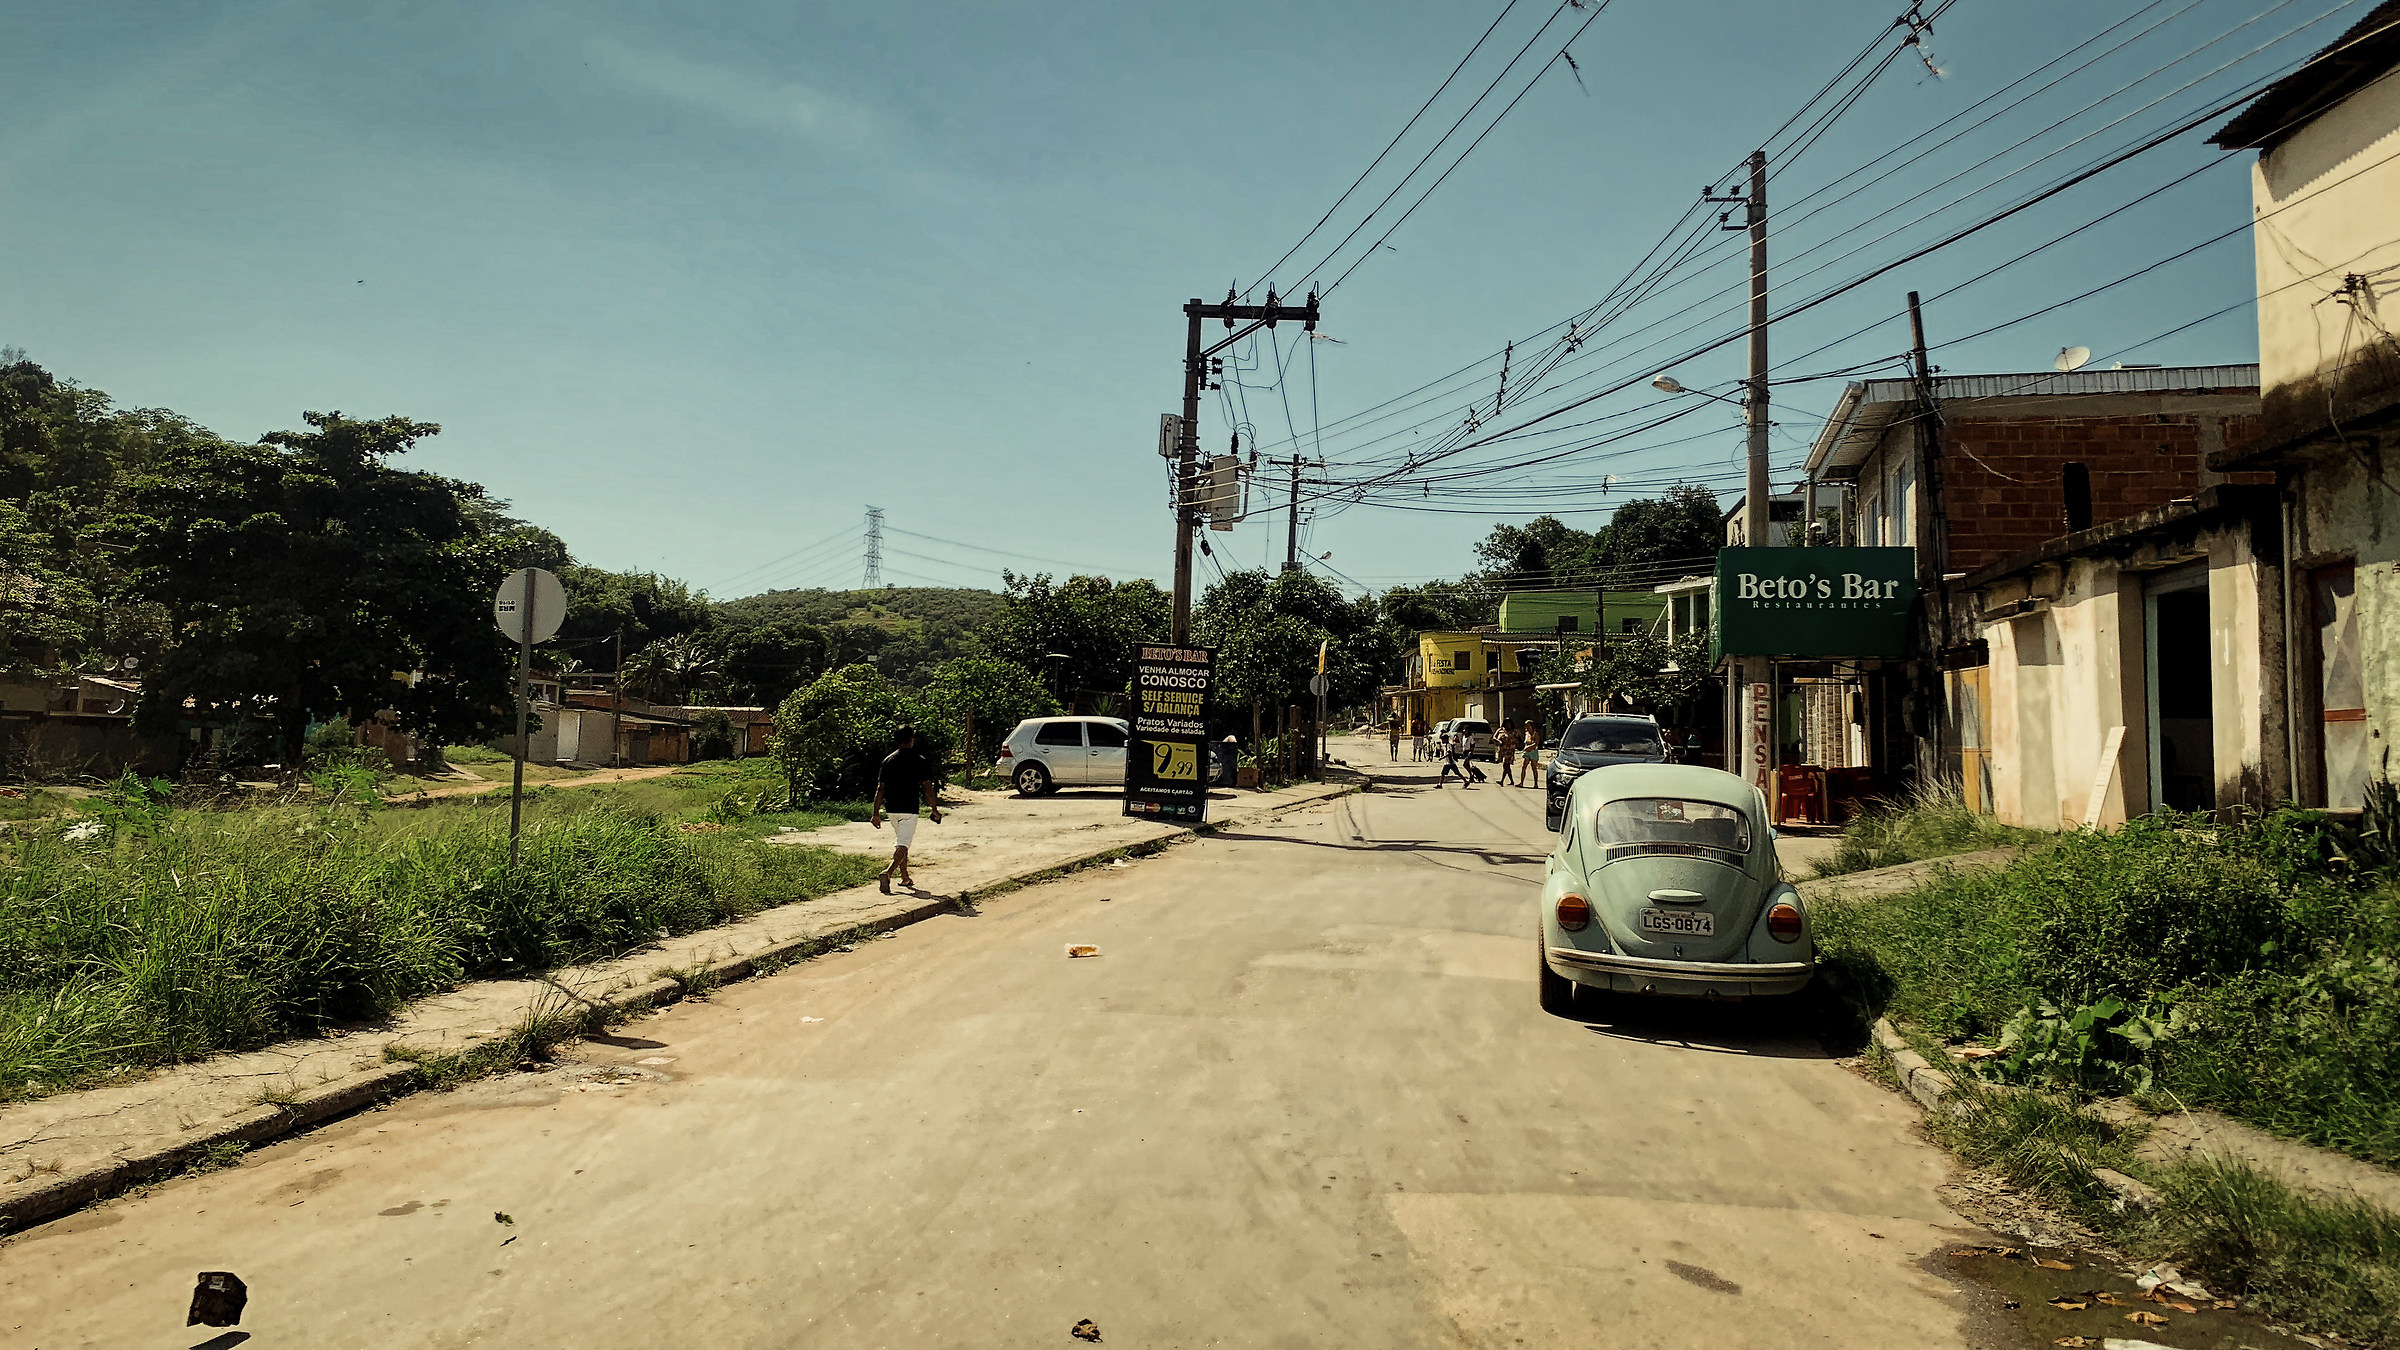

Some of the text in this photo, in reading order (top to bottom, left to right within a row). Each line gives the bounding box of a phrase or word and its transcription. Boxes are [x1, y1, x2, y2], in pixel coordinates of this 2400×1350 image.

[1737, 573, 1899, 599] Beto's Bar
[1752, 600, 1881, 609] Restaurantes
[1141, 647, 1208, 663] BETO'S BAR
[1139, 666, 1210, 677] VENHA ALMOÇAR
[1140, 675, 1207, 689] CONOSCO
[1141, 690, 1204, 705] SELF SERVICE
[1143, 701, 1200, 717] S/ BALANÇA
[1135, 724, 1170, 733] Variedade
[1181, 727, 1205, 735] saladas
[1137, 717, 1204, 728] Pratos Variados
